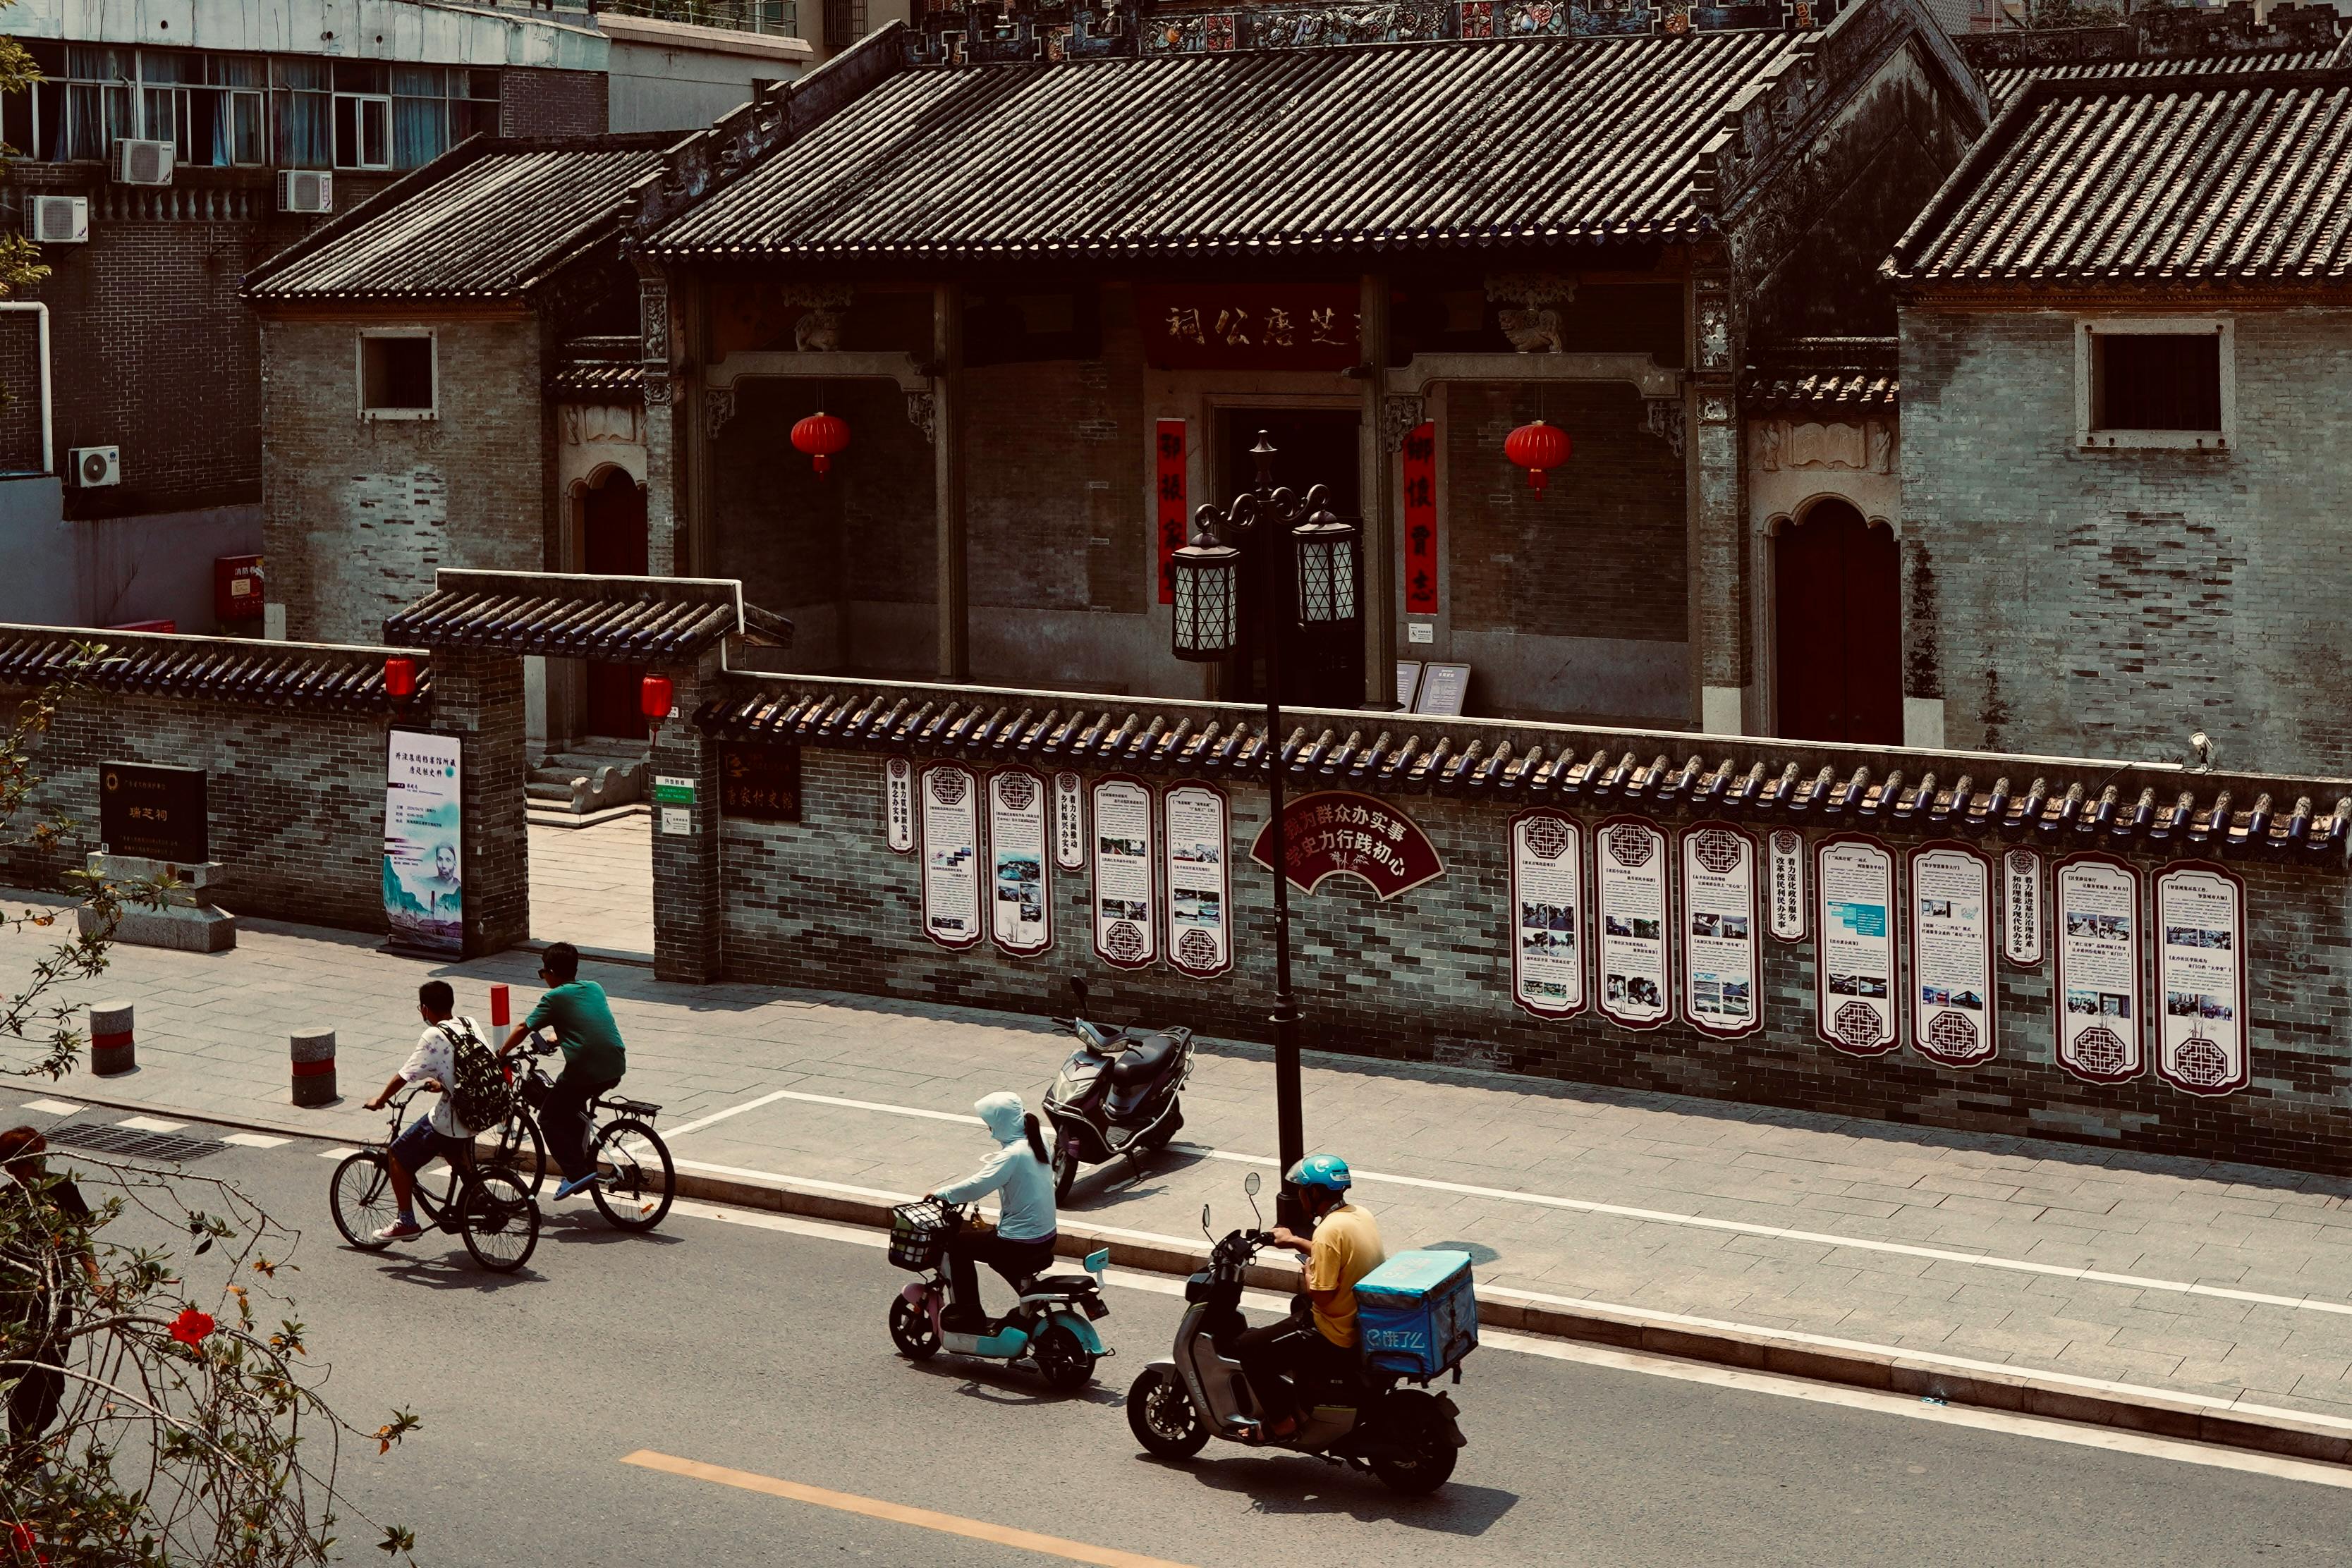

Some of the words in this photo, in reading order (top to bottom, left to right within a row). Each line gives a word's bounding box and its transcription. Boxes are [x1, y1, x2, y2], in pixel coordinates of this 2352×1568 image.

[129, 807, 168, 821] 瑞芝祠
[891, 780, 900, 824] 理念办实事
[900, 780, 908, 842] 着力贯彻新发展
[1061, 795, 1069, 857] 乡村振兴办实事
[1069, 795, 1078, 848] 着力全面推动
[1284, 803, 1408, 843] 我为群众办实事
[1286, 829, 1406, 877] 学史力行践初心
[1776, 856, 1786, 929] 改革便民利民办实事
[1787, 857, 1797, 922] 着力深化政务服务
[2011, 875, 2023, 954] 和治理能力现代化办实事
[2024, 876, 2035, 948] 着力推进基层治理体系
